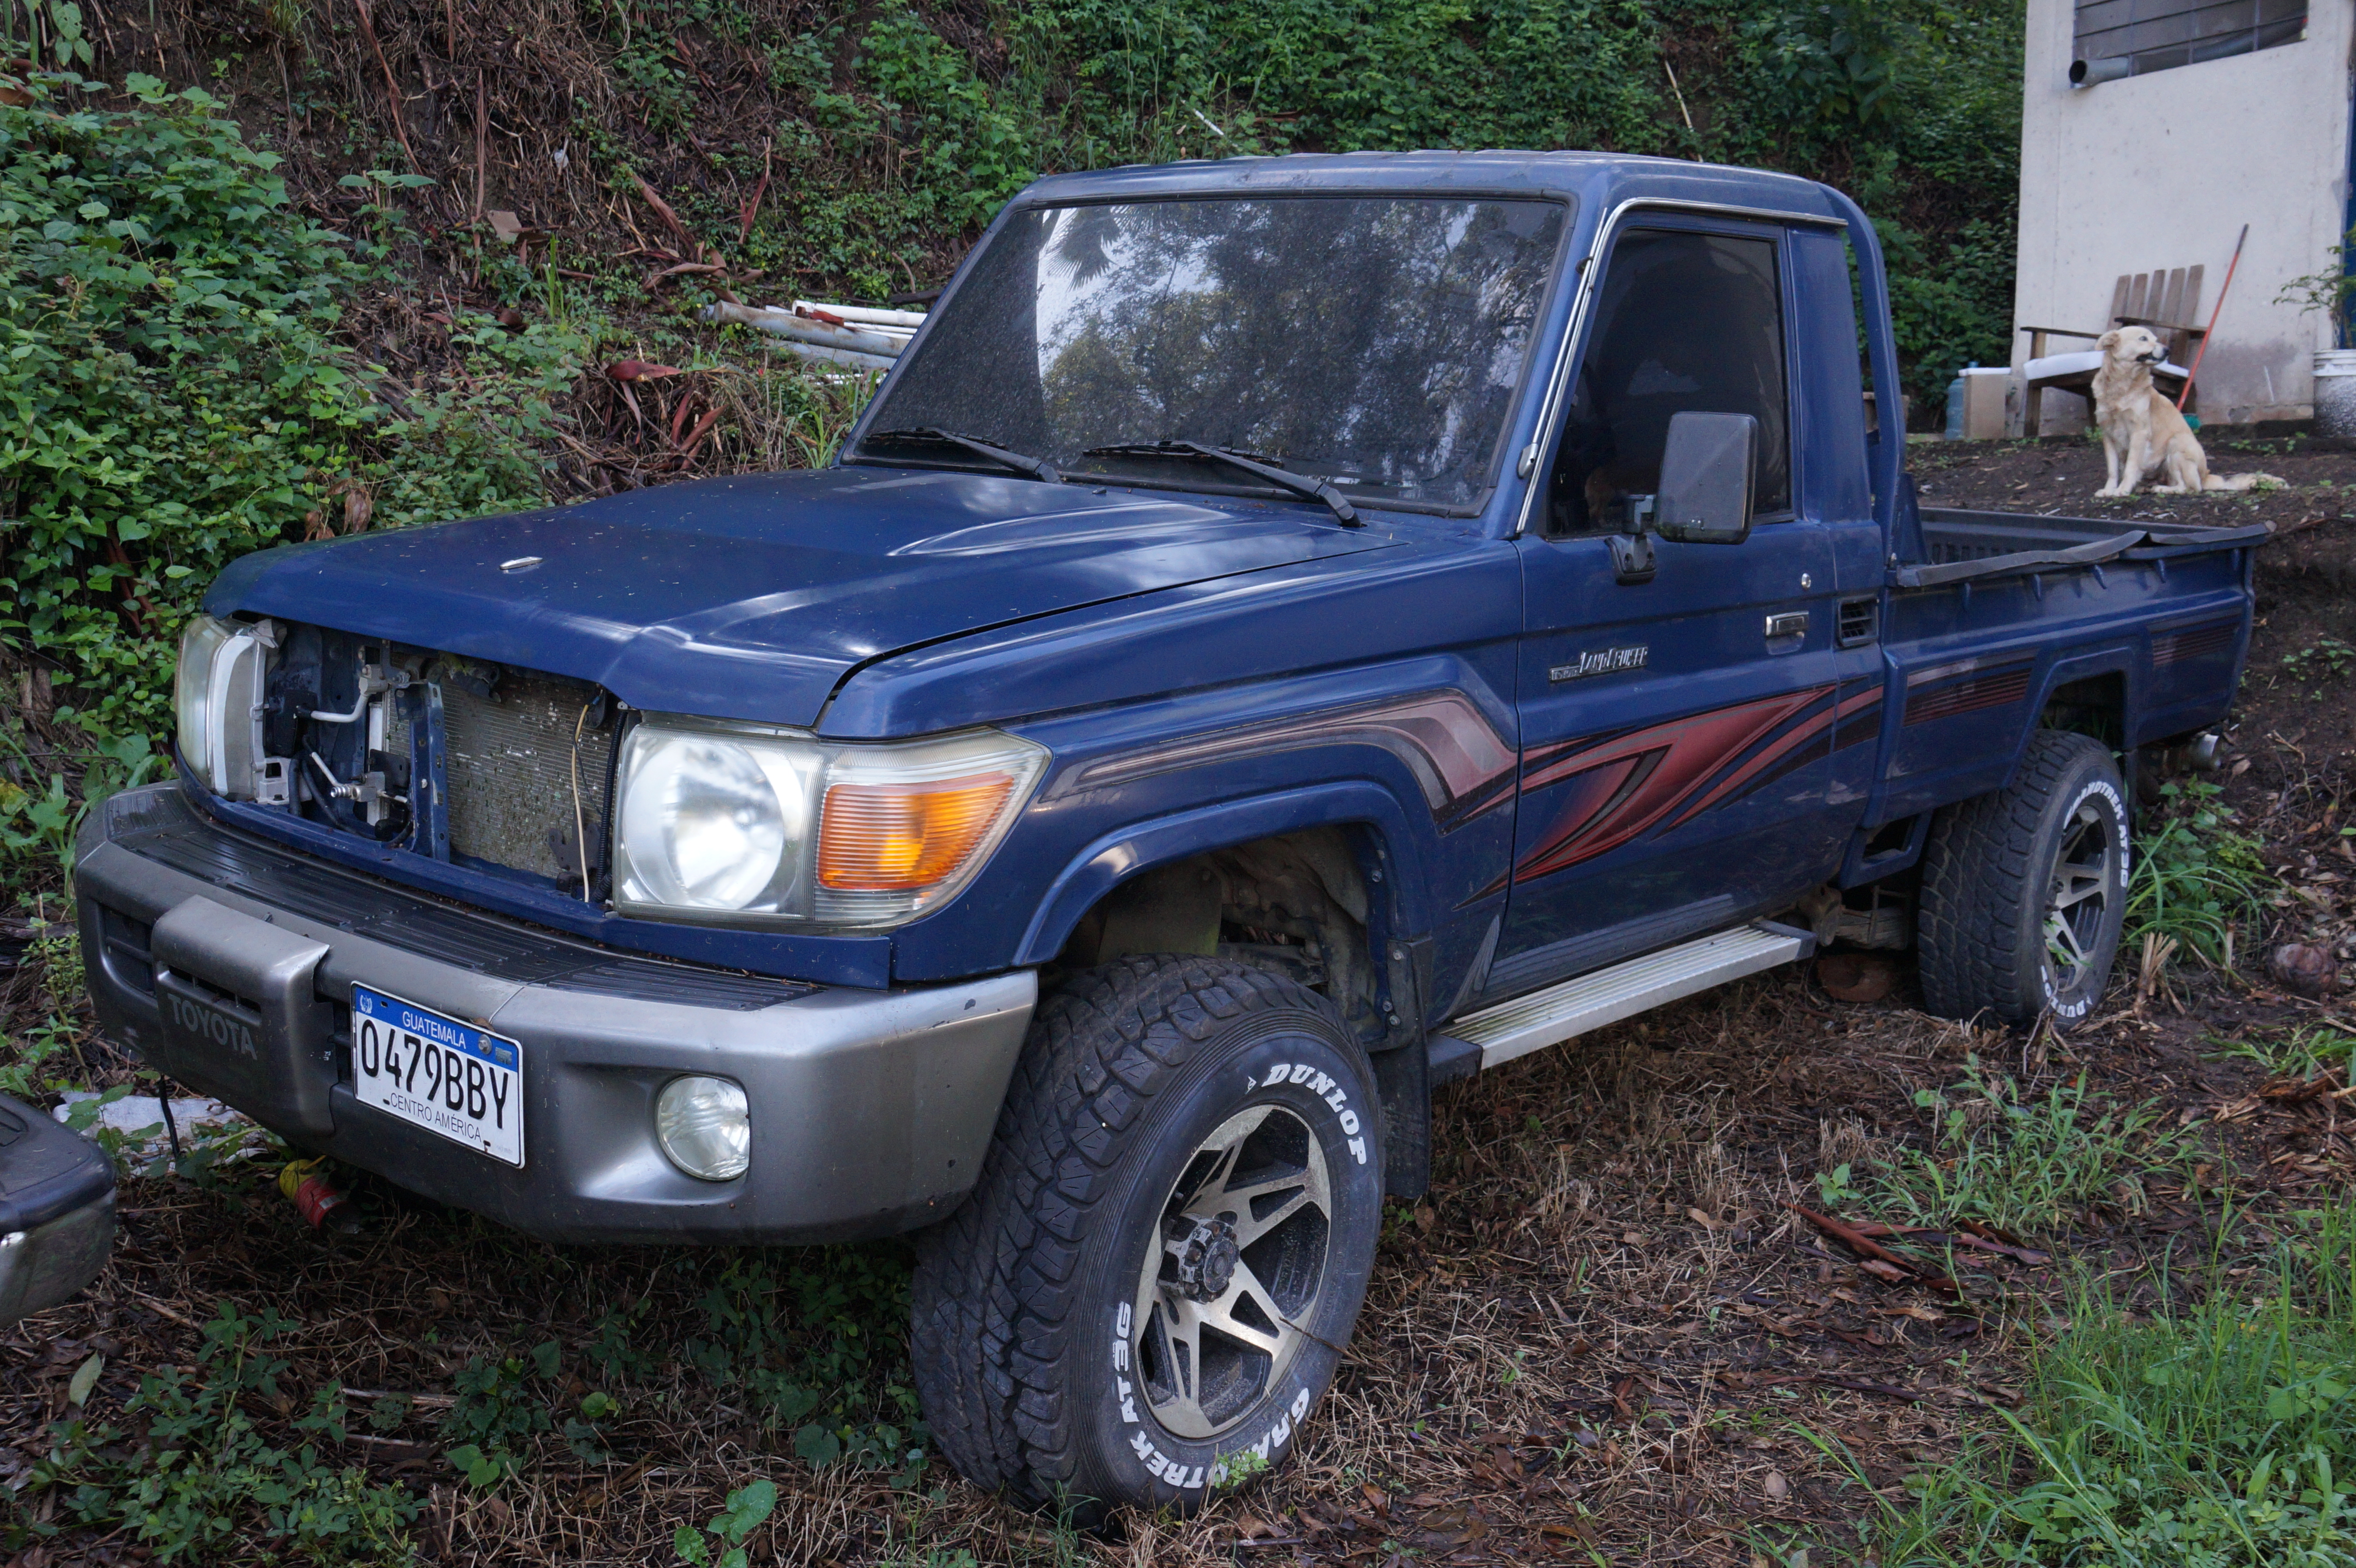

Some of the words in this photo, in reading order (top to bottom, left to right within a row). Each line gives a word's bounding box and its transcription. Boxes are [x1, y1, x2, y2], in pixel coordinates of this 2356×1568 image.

[167, 993, 257, 1060] TOYOTA
[402, 1011, 466, 1049] GUATEMALA
[361, 1019, 509, 1129] 0479BBY
[1261, 1063, 1367, 1165] DUNLOP
[390, 1093, 432, 1121] CENTRO
[435, 1110, 481, 1142] AMÉRICA
[1114, 1301, 1140, 1423] AT3G
